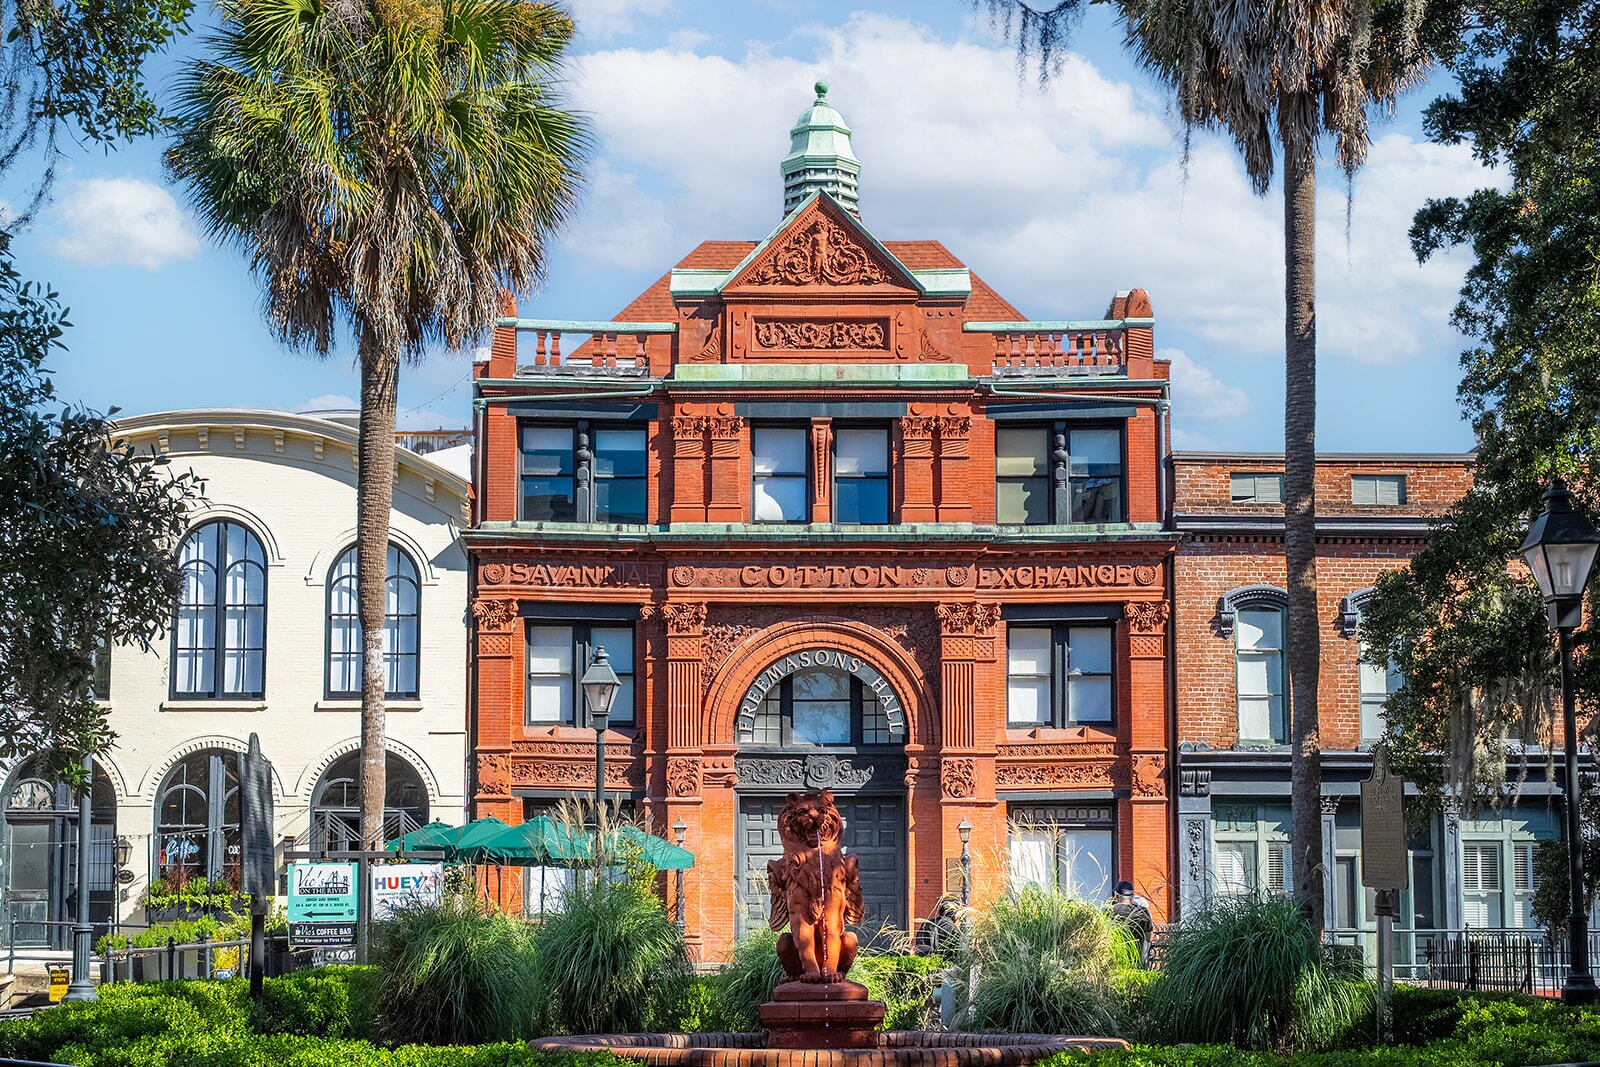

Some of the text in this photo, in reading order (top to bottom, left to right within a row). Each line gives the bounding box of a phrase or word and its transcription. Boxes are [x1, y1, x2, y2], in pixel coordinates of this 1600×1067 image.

[511, 563, 1131, 587] SAVANNAH COTTON EXCHANGE
[870, 676, 903, 733] HALL
[166, 840, 200, 859] Coffee
[296, 866, 325, 887] Vic's
[374, 876, 440, 890] HUEY'S
[299, 924, 352, 936] Vic's COFFEE BAR
